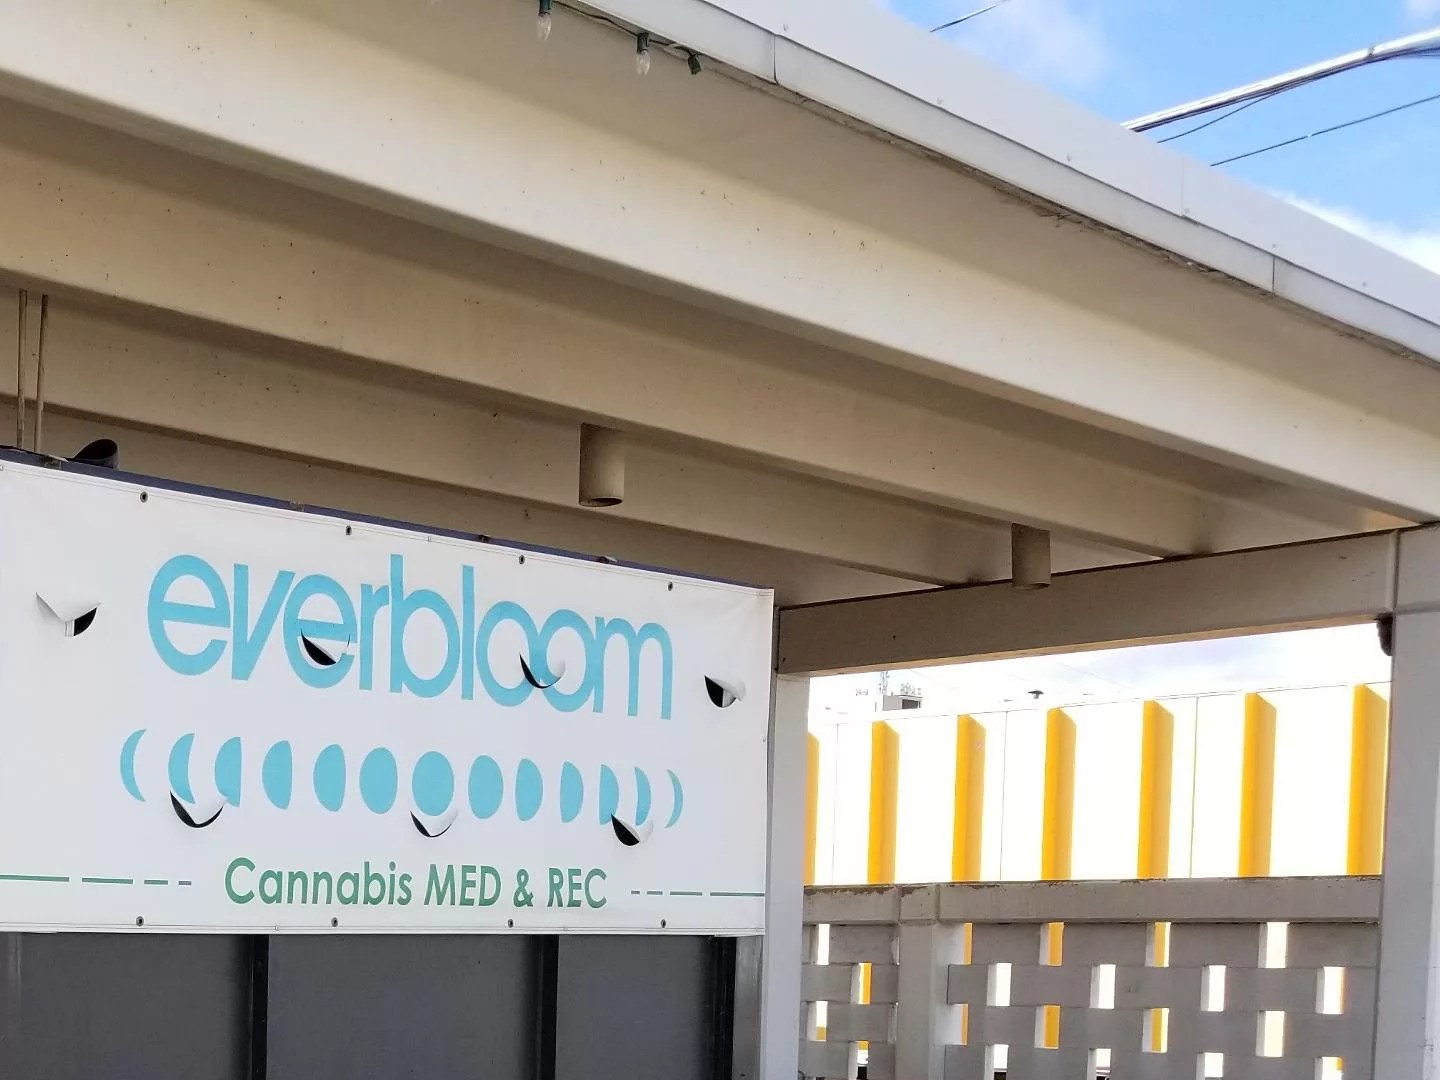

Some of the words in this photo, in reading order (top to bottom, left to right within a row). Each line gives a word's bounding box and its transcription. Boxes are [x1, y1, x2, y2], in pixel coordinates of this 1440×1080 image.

[148, 555, 672, 719] everbloom
[225, 857, 412, 906] Cannabis
[425, 864, 501, 907] MED
[513, 869, 534, 907] &
[548, 868, 607, 909] REC
